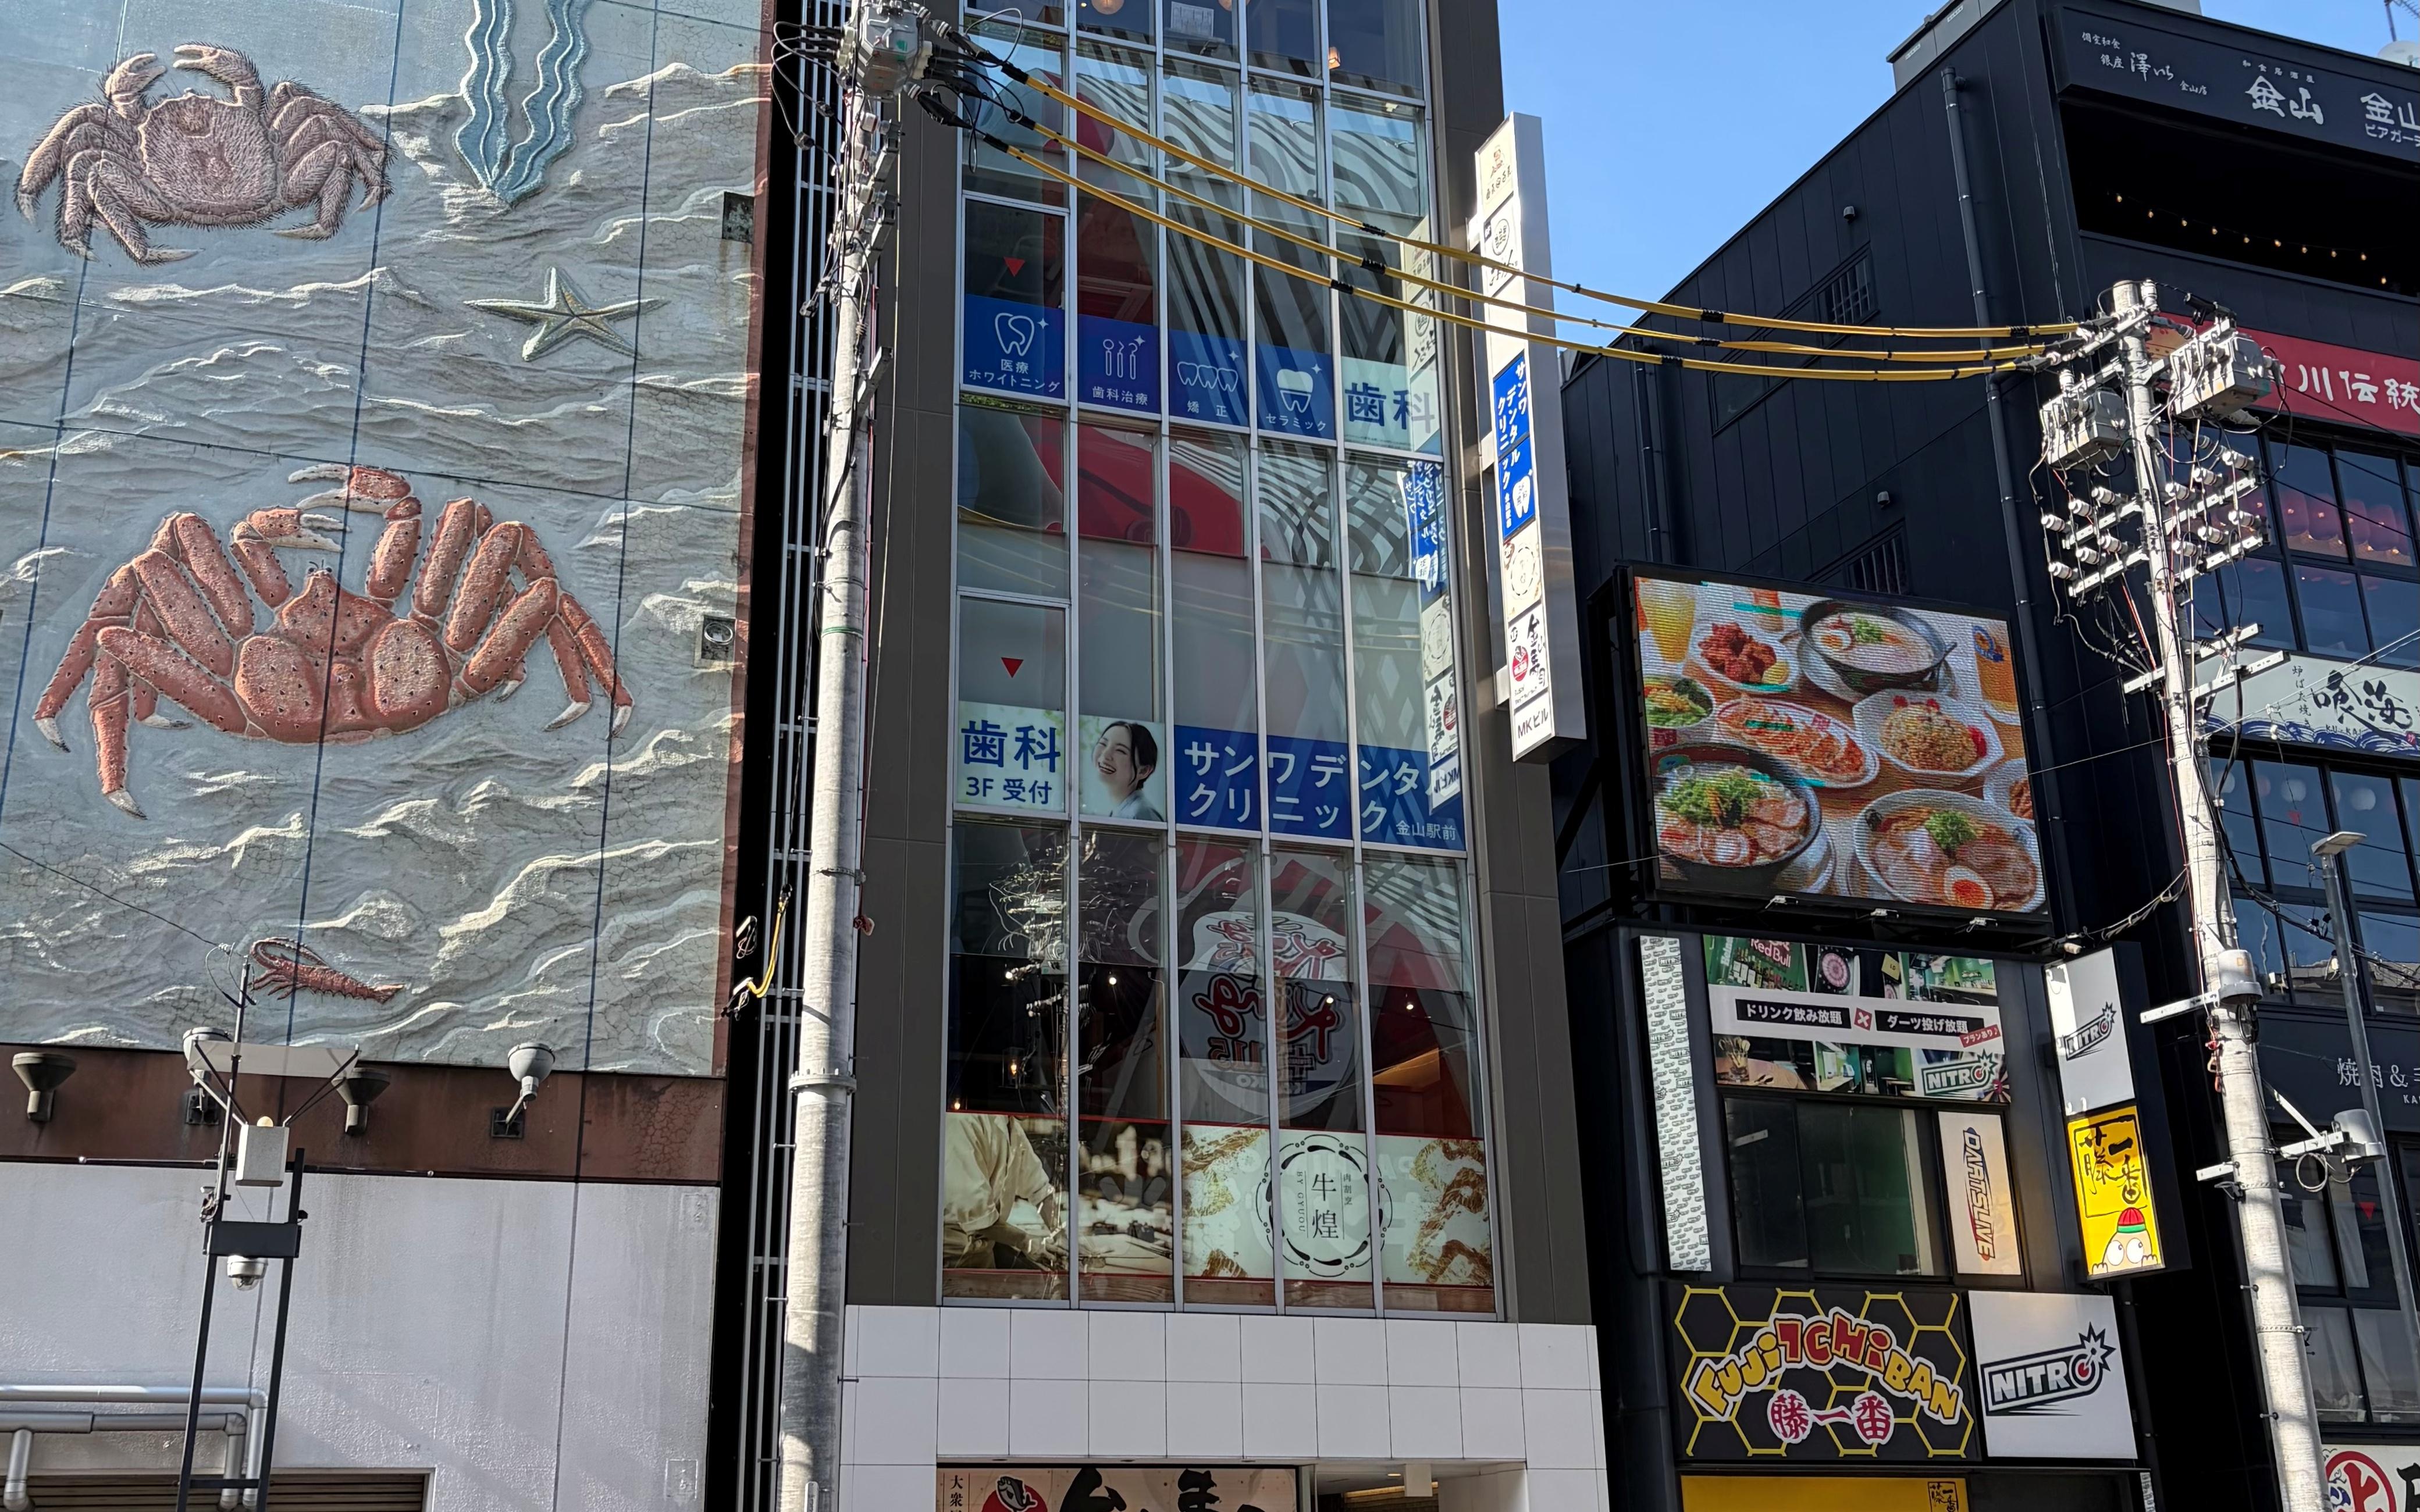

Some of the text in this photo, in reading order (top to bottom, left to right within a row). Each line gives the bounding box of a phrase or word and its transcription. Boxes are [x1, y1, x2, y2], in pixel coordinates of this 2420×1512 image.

[2100, 54, 2124, 69] 銀座
[969, 369, 1060, 393] ホワイトニング
[1001, 359, 1029, 375] 医療
[1092, 386, 1148, 406] 歯科治療
[1515, 361, 1527, 415] サンワ
[2275, 364, 2420, 416] 川伝統
[1265, 413, 1326, 432] セラミック
[1345, 381, 1435, 434] 歯科
[1507, 384, 1521, 466] デンタル
[1498, 397, 1511, 490] クリニック
[960, 719, 1060, 772] 歯科
[966, 777, 1052, 804] 3F 受付
[1188, 783, 1386, 833] クリニック
[1397, 819, 1457, 841] 金山駅前
[1750, 939, 1791, 968] Red Bull
[1746, 1003, 1843, 1025] ドリンク飲み放題
[1887, 1015, 1969, 1034] ダーツ投げ放題
[2067, 1018, 2109, 1055] NITRO
[1927, 1065, 1987, 1091] NITRO
[2403, 1094, 2420, 1104] KA
[1297, 1171, 1304, 1185] BY
[1963, 1129, 1996, 1259] DARTSLIVE
[1311, 1172, 1339, 1239] 牛煌
[1994, 1349, 2098, 1403] NITRO
[1770, 1395, 1894, 1441] 藤一番
[950, 1474, 964, 1512] 大衆
